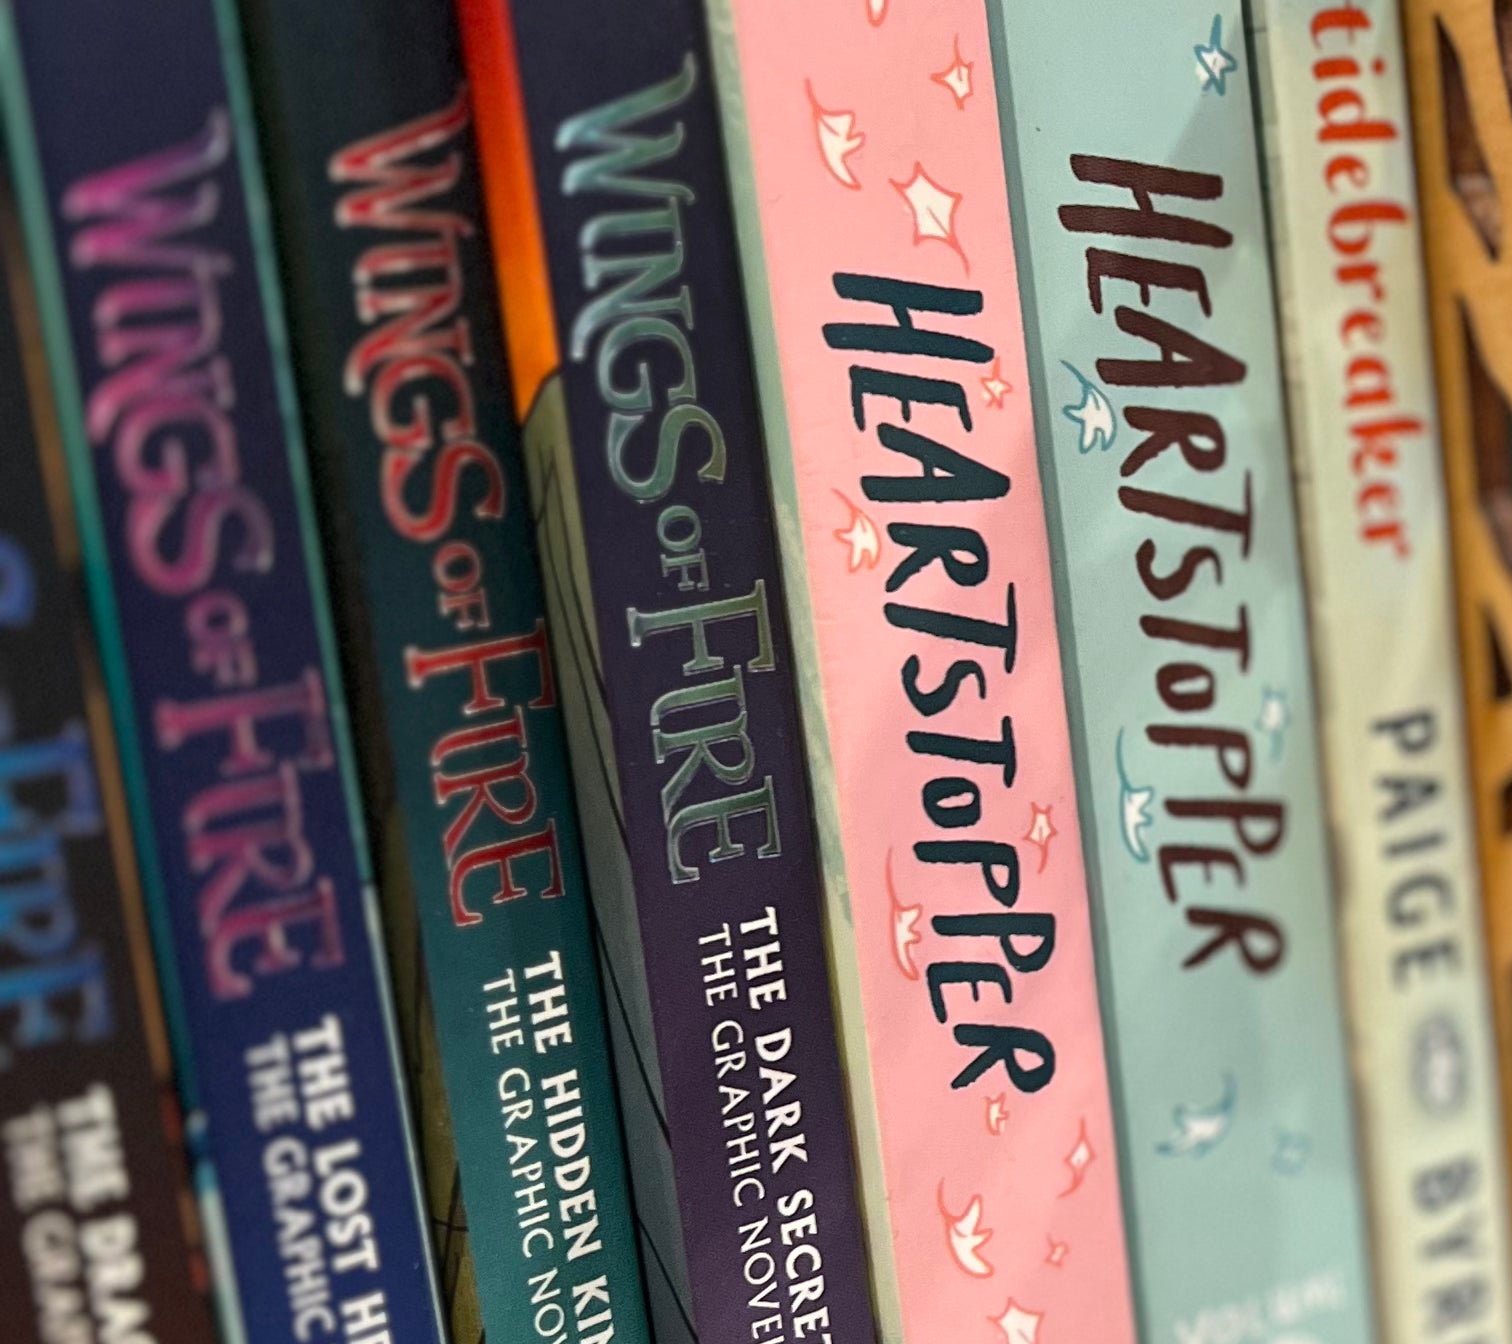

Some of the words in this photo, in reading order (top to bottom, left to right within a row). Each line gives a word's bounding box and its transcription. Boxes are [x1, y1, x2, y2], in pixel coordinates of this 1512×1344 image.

[62, 106, 274, 597] WINGS
[329, 81, 506, 542] WINGS
[556, 53, 728, 504] WINGS
[186, 590, 260, 688] OF
[430, 541, 491, 632] OF
[656, 505, 710, 592] OF
[1057, 152, 1290, 978] HEARTSTOPPER
[404, 617, 568, 930] FIRE
[626, 578, 783, 885] FIRE
[820, 271, 1058, 1095] HEARTSTOPPER
[151, 666, 347, 1002] FIRE
[1366, 705, 1463, 994] PAIGE
[481, 966, 524, 1056] THE
[522, 949, 575, 1056] THE
[698, 922, 737, 1008] THE
[739, 904, 788, 1012] THE
[54, 1081, 132, 1212] THE
[245, 1033, 300, 1134] THE
[290, 1014, 355, 1130] THE
[496, 1064, 556, 1261] GRAPHIC
[540, 1066, 605, 1263] HIDDEN
[712, 1019, 766, 1209] GRAPHIC
[754, 1024, 810, 1182] DARK
[261, 1134, 336, 1343] GRAPHIC
[314, 1138, 381, 1275] LOST
